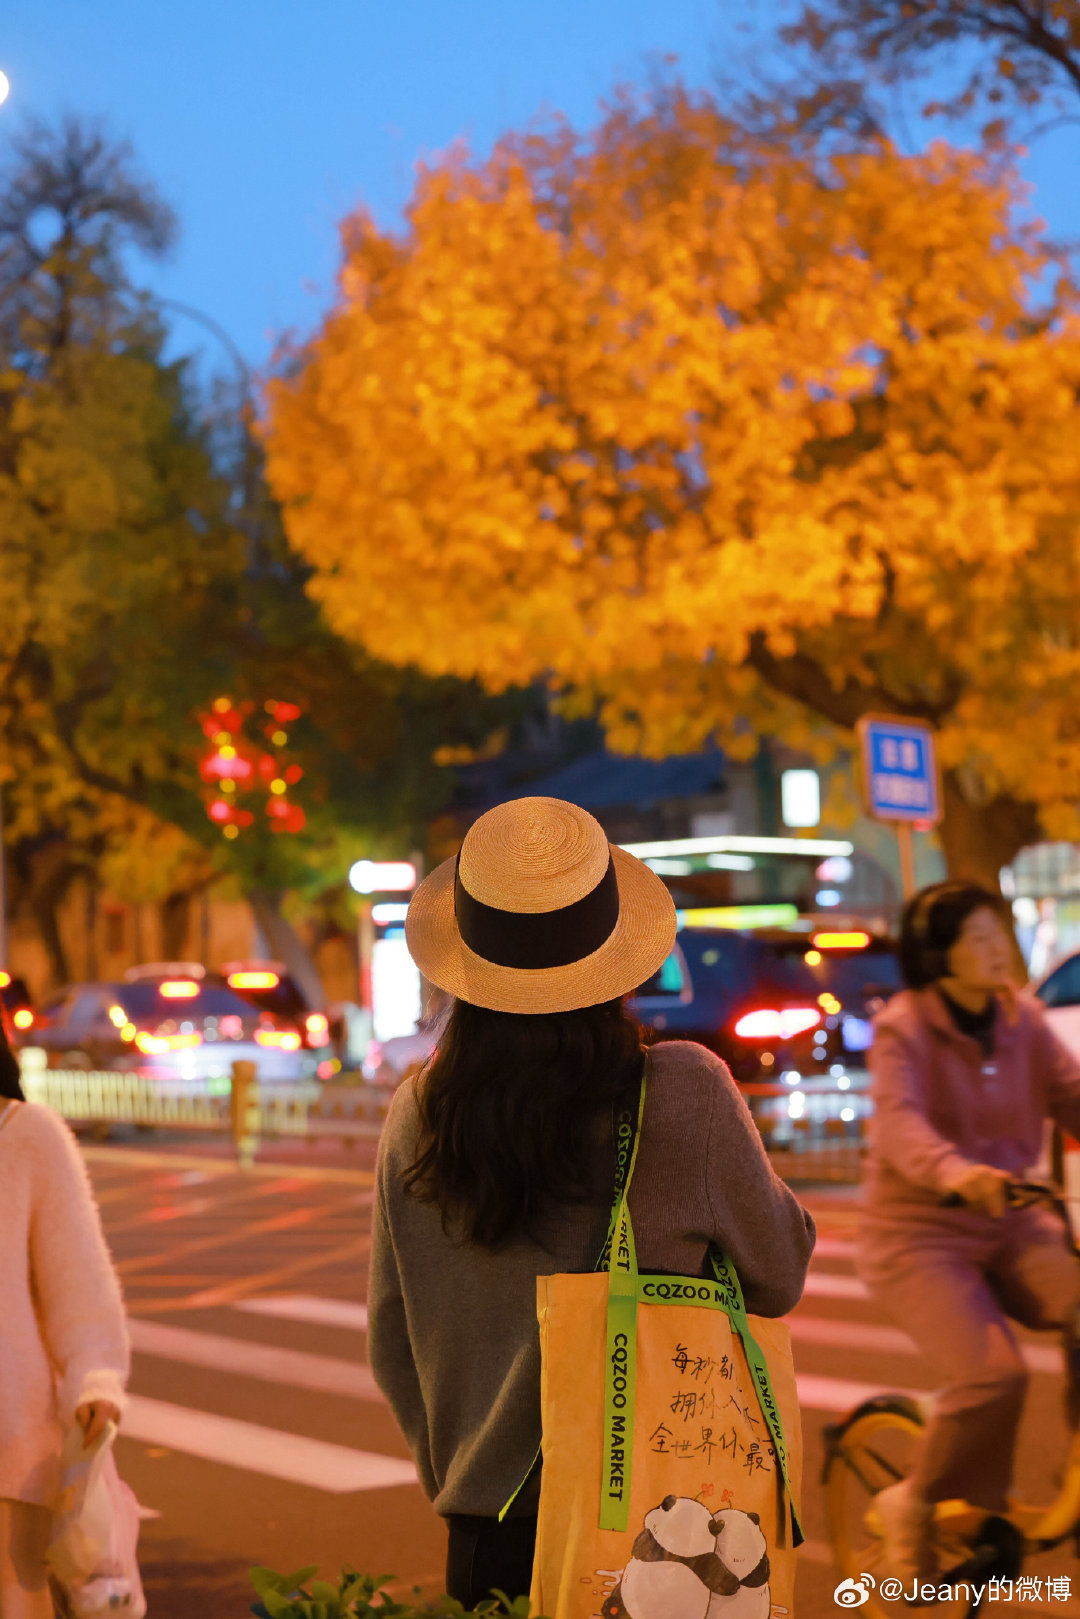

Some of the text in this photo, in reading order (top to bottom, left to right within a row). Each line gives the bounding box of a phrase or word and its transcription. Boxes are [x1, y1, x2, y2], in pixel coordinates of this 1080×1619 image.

[617, 1202, 630, 1272] RKET
[643, 1283, 711, 1300] CQZOO
[609, 1333, 628, 1502] CQZOO MARKET
[754, 1363, 783, 1440] MARKET
